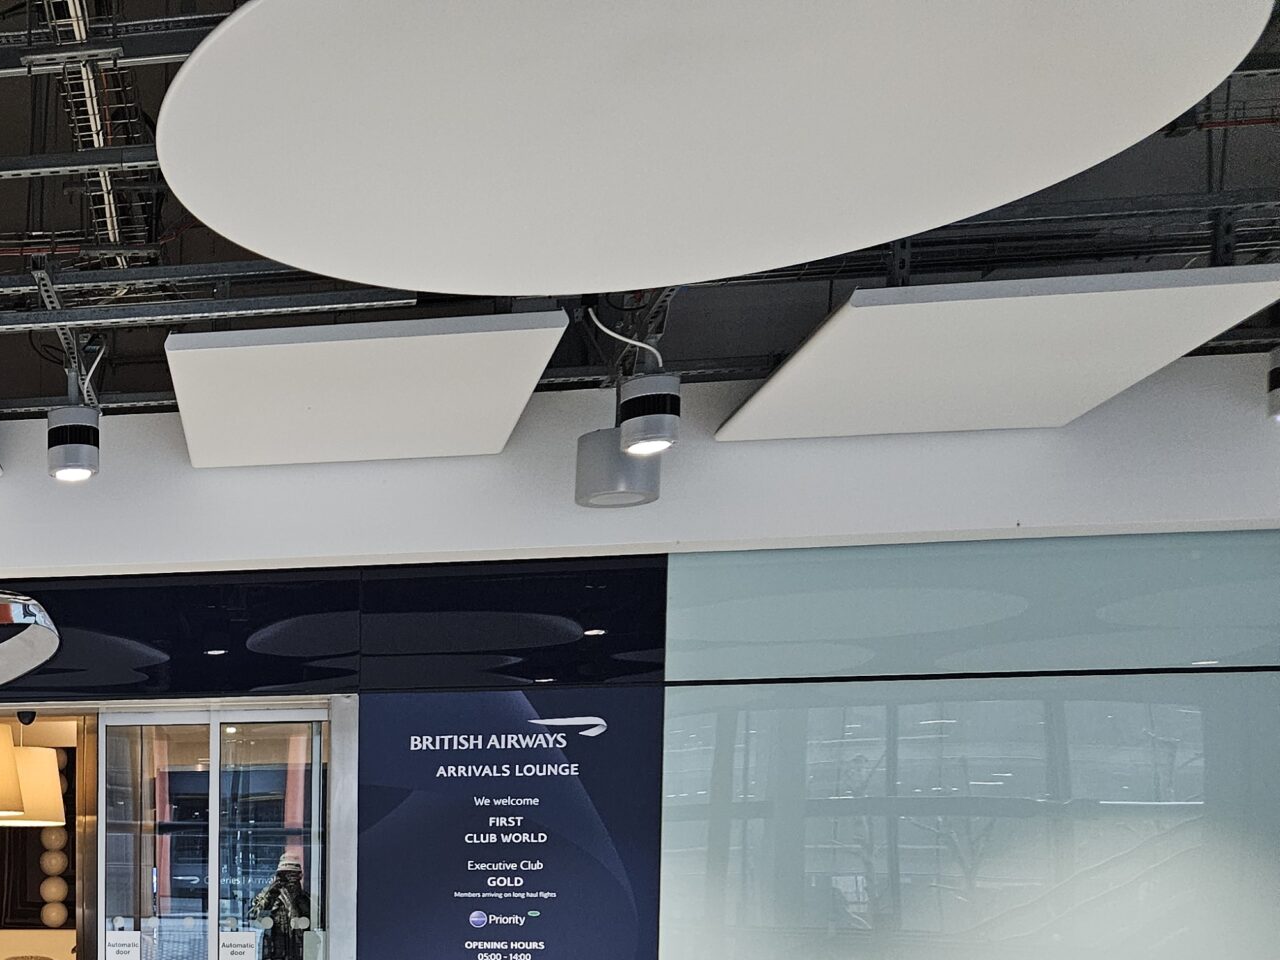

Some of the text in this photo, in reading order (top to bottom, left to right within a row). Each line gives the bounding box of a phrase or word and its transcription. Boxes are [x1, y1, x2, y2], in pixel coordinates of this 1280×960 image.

[410, 733, 567, 751] BRITISH AIRWAYS
[436, 763, 580, 778] ARRIVALS LOUNGE
[473, 796, 540, 806] We welcome
[488, 816, 524, 827] FIRST
[464, 832, 548, 844] CLUB WORLD
[467, 859, 544, 871] Executive Club
[487, 876, 524, 887] GOLD
[512, 891, 526, 899] long
[538, 891, 557, 899] flights
[488, 914, 526, 926] Priority
[107, 941, 139, 949] Automatic
[221, 941, 255, 949] Automatic
[464, 941, 545, 950] OPENING HOURS
[115, 948, 131, 956] door
